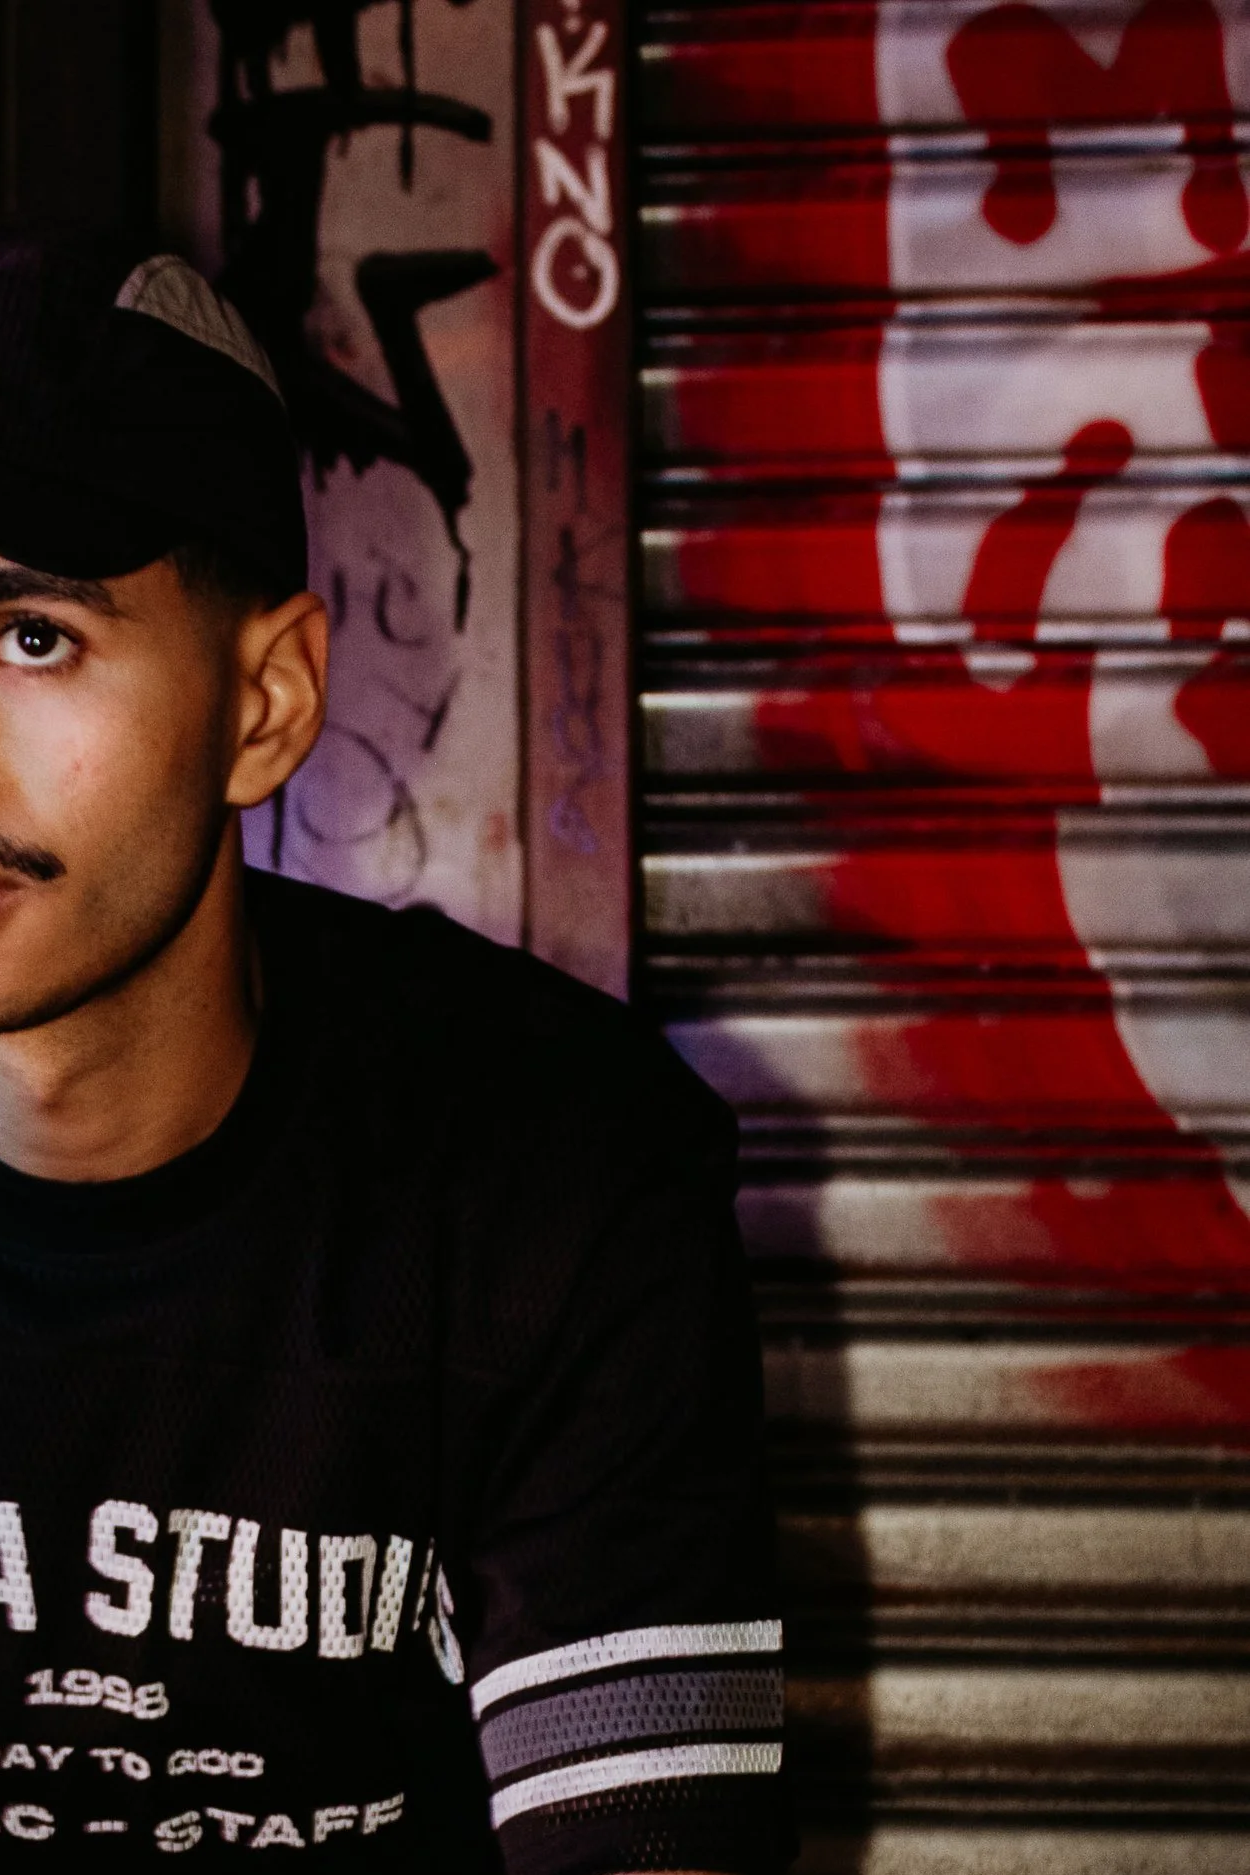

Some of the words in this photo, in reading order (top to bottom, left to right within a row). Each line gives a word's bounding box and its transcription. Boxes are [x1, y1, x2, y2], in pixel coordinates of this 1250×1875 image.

[24, 1668, 170, 1719] 1998
[88, 1747, 151, 1781] TO
[166, 1748, 265, 1778] GOD
[154, 1792, 404, 1852] STAFF
